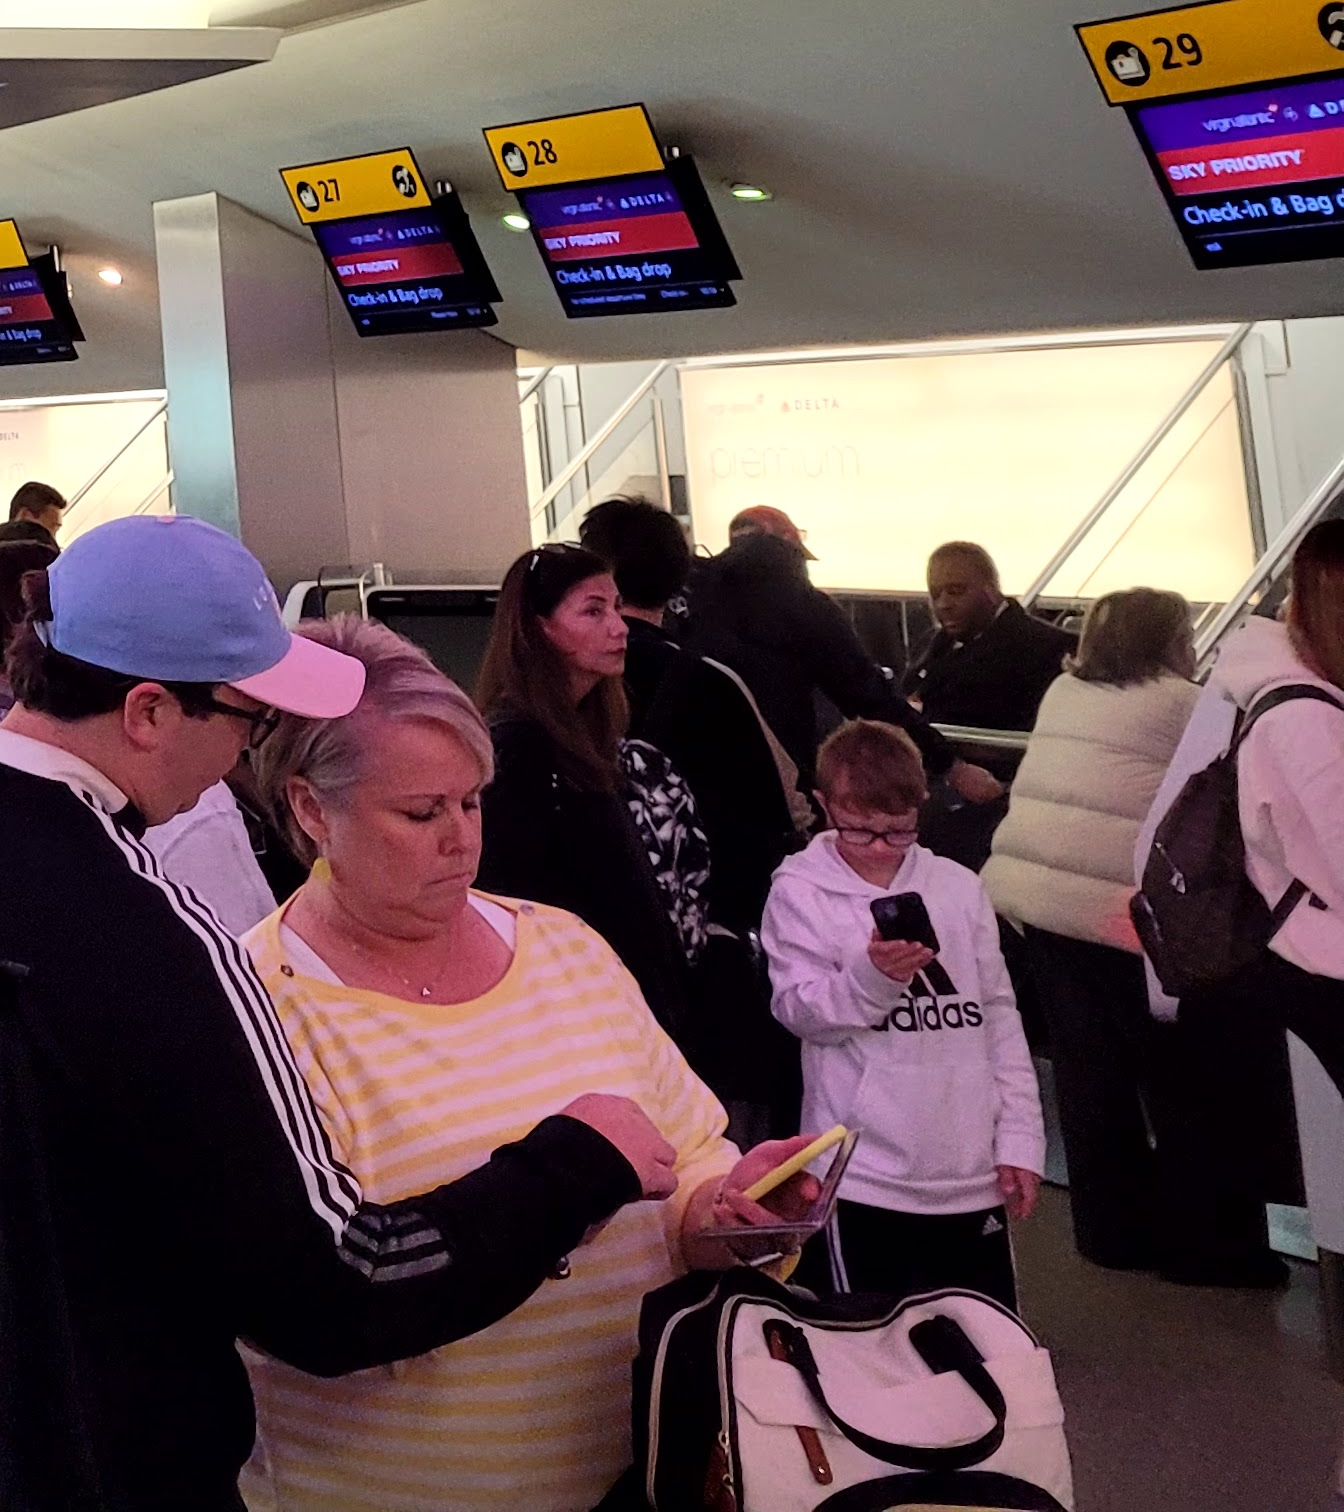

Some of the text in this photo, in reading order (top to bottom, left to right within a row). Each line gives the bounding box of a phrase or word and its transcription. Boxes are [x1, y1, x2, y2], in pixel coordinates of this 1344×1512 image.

[1152, 33, 1202, 70] 29
[527, 139, 557, 165] 28
[1168, 149, 1305, 180] SKY PRIORITY
[317, 178, 340, 202] 27
[629, 193, 665, 208] DELTA
[1269, 197, 1289, 215] &
[1289, 194, 1334, 215] Bag
[616, 264, 642, 282] Bag
[642, 262, 672, 278] drop
[794, 398, 841, 411] DELTA
